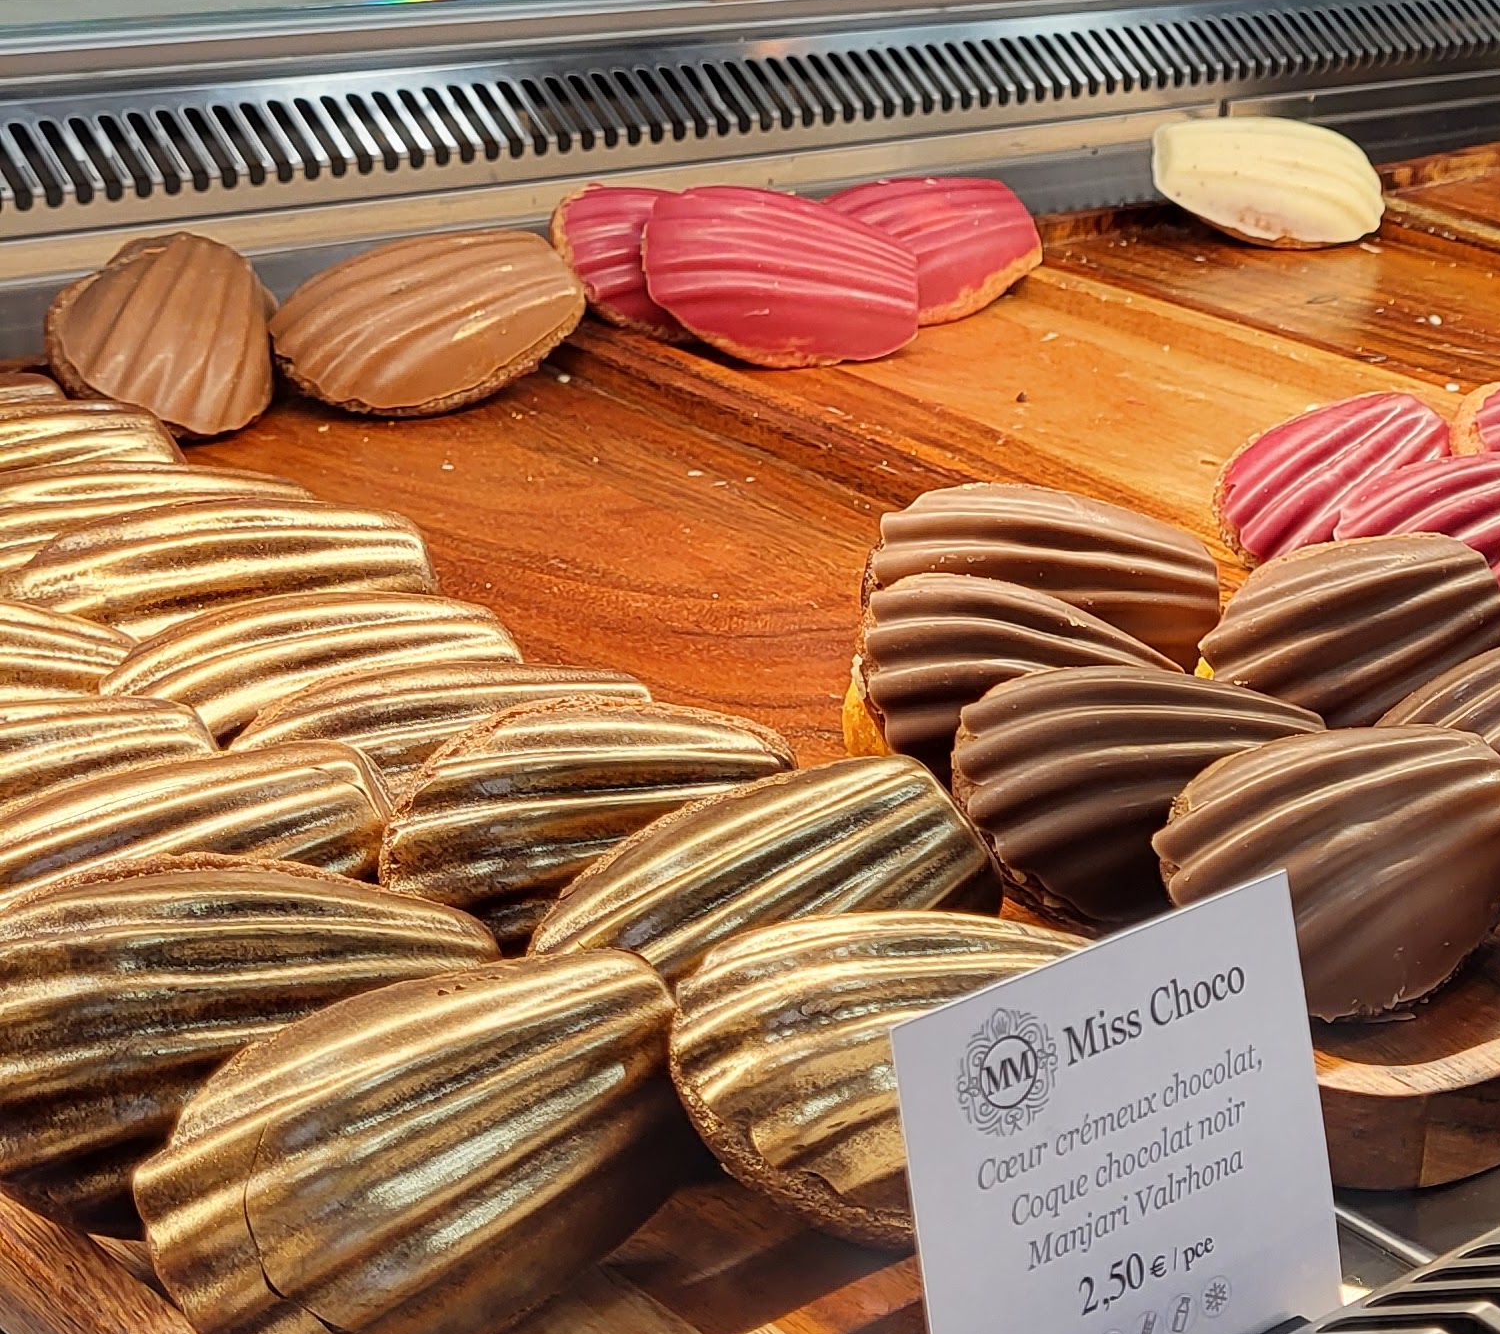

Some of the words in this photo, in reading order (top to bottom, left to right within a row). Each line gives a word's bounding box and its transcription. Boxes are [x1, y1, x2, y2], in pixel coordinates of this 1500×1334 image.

[1063, 1008, 1142, 1067] Miss
[1150, 965, 1247, 1029] Choco
[977, 1138, 1049, 1192] Cœur
[1054, 1091, 1157, 1158] crémeux
[1162, 1041, 1265, 1115] chocolat,
[985, 1051, 1037, 1098] MM
[1012, 1169, 1089, 1227] Coque
[1095, 1121, 1194, 1188] chocolat
[1198, 1096, 1247, 1141] noir
[1029, 1199, 1130, 1273] Manjari
[1134, 1145, 1245, 1219] Valrhona
[1078, 1250, 1145, 1317] 2,50
[1182, 1234, 1215, 1273] pce
